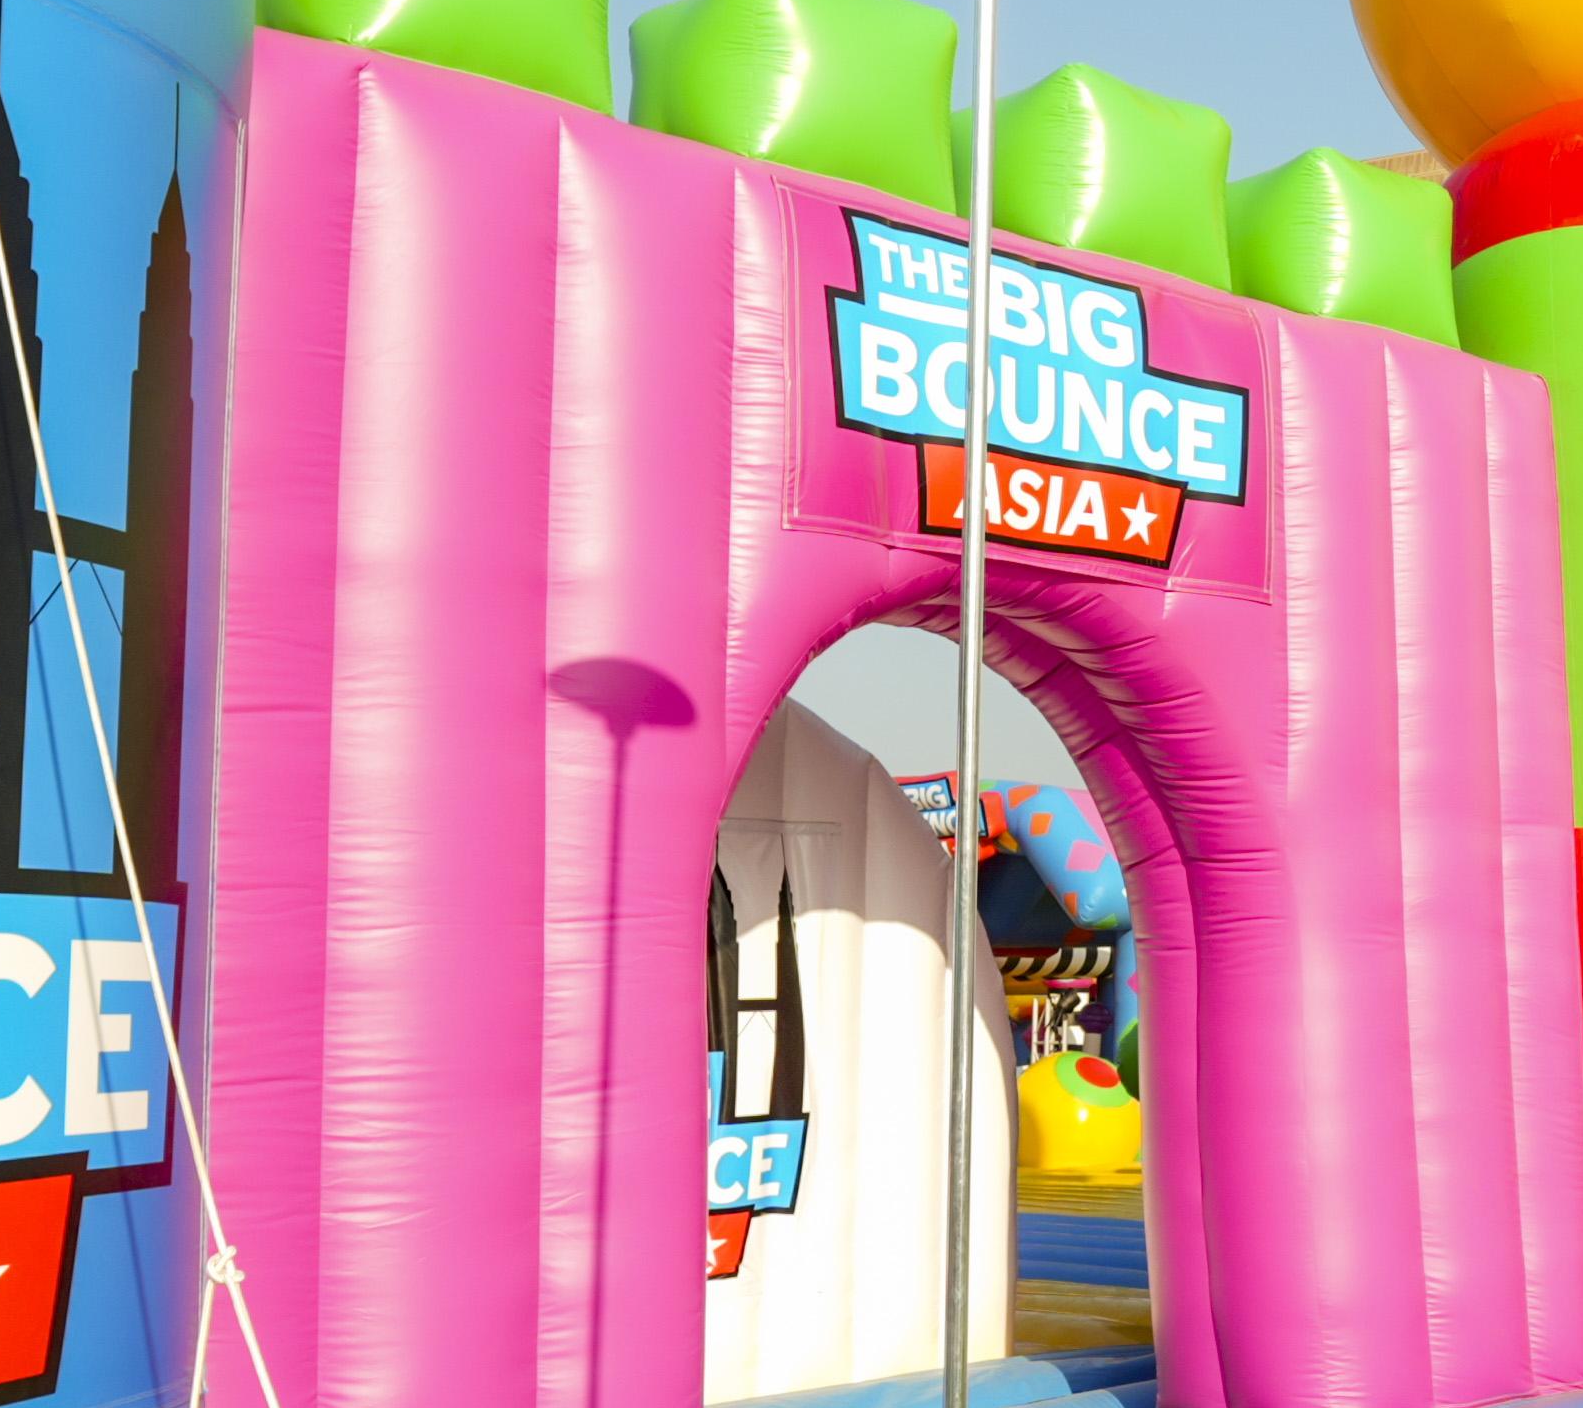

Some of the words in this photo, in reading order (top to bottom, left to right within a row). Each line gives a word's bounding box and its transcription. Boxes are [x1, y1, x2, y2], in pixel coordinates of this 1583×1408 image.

[869, 233, 970, 295] THE
[987, 261, 1137, 368] BIG
[859, 321, 1227, 482] BOUNCE
[953, 460, 1110, 542] ASIA
